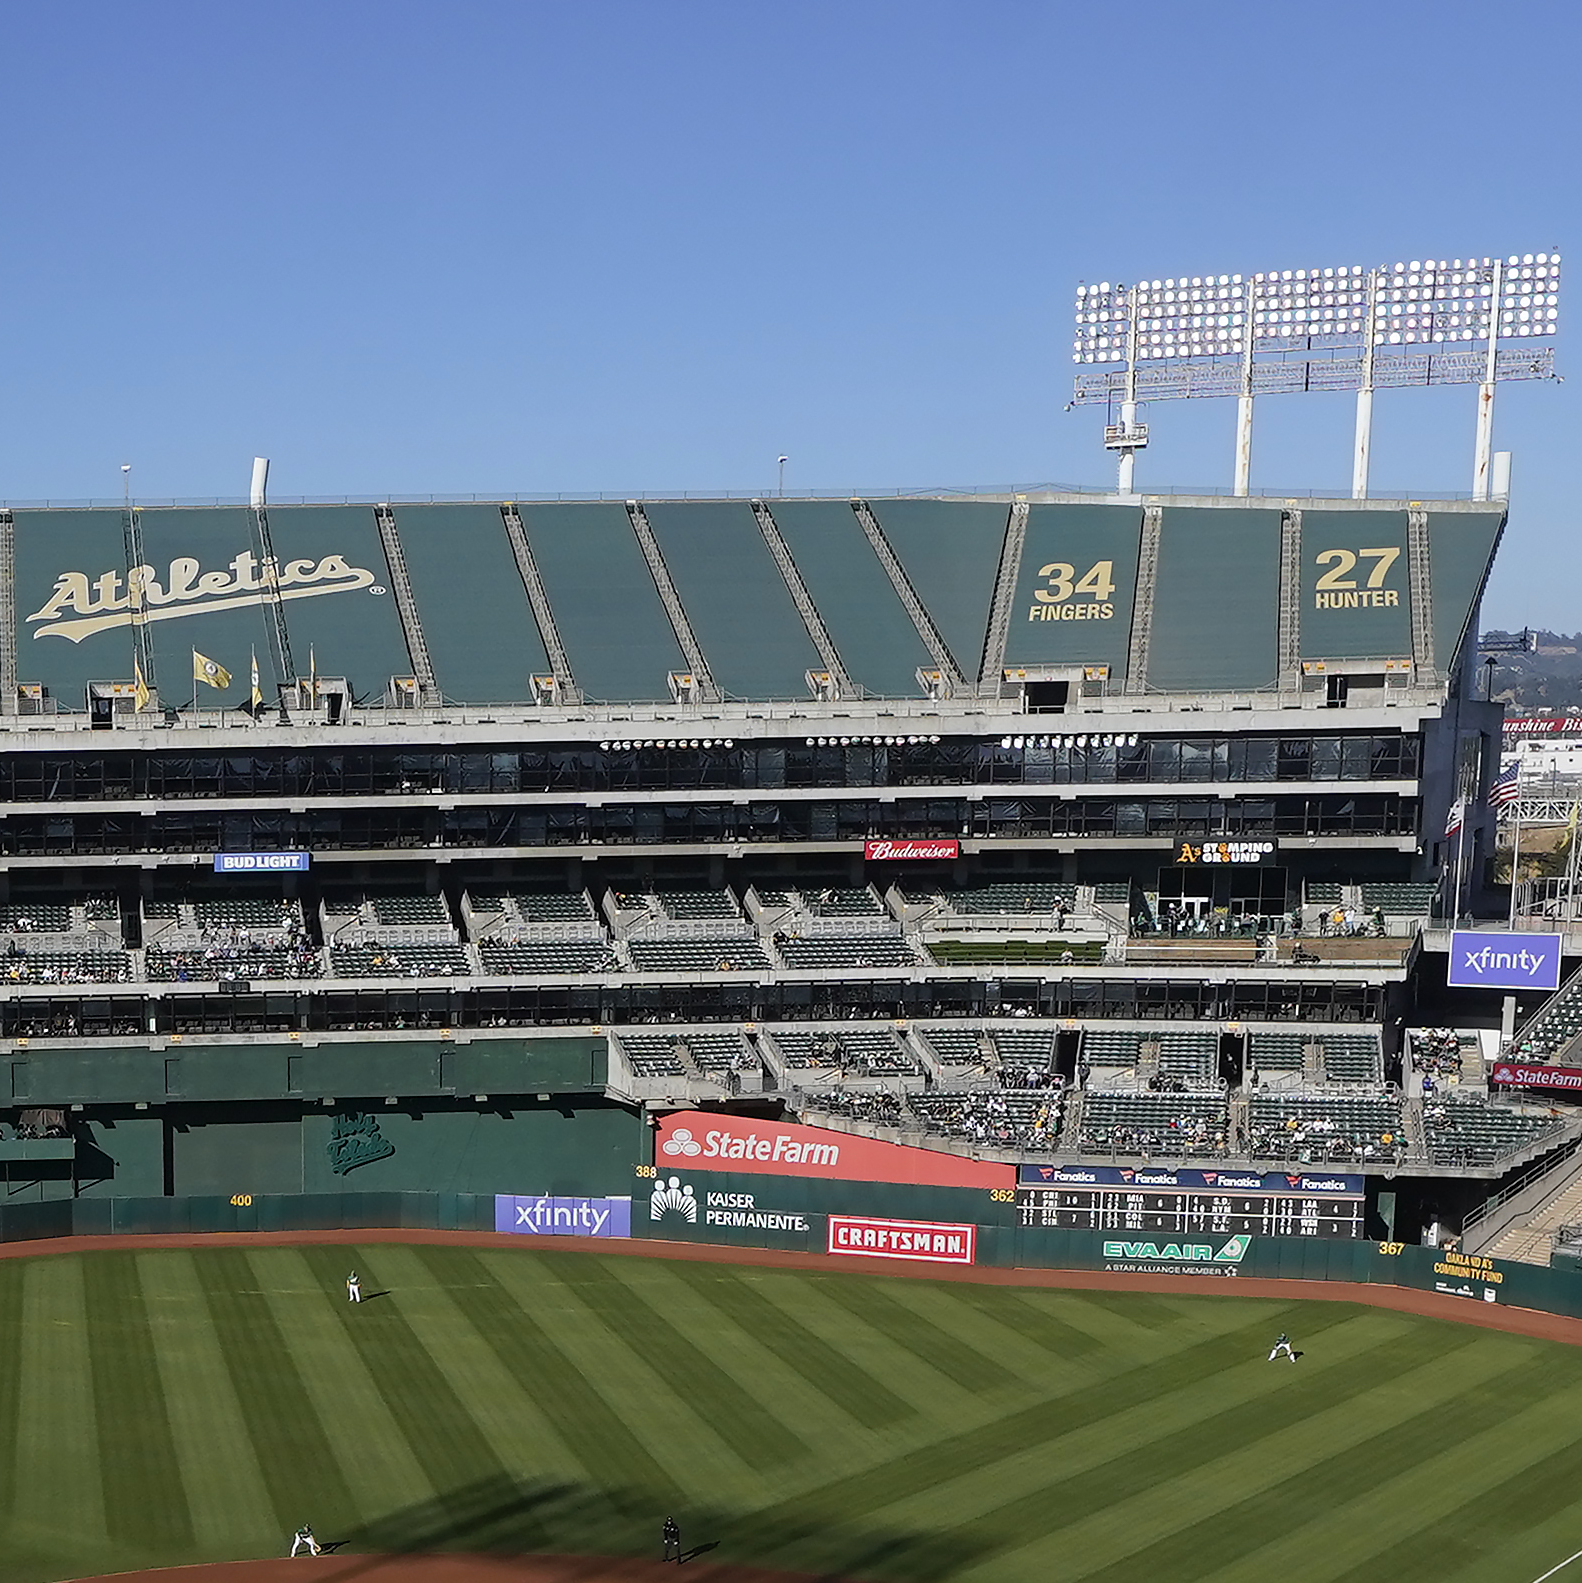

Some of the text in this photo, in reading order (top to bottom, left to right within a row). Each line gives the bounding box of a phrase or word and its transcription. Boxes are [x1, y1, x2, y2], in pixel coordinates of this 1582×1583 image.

[1315, 547, 1400, 589] 27
[1034, 560, 1115, 602] 34
[25, 550, 377, 643] Athletics
[1315, 590, 1399, 609] HUNTER
[1029, 602, 1115, 621] FINGERS
[1502, 718, 1555, 731] unshine
[869, 842, 954, 859] Budweiser
[1177, 843, 1201, 862] A's
[1202, 843, 1273, 853] STOMPING
[224, 856, 300, 868] BUD LIGHT
[1202, 853, 1260, 862] GROUND
[1465, 947, 1545, 976] xfinity
[635, 1165, 657, 1178] 388
[1054, 1171, 1096, 1182] Fanatics
[1135, 1173, 1177, 1184] Fanatics
[1218, 1176, 1261, 1187] Fanatics
[1302, 1179, 1346, 1190] Fanatics
[230, 1193, 252, 1207] 400
[707, 1192, 755, 1208] KAISER
[990, 1188, 1015, 1203] 362
[516, 1200, 609, 1235] xfinity
[706, 1212, 804, 1231] PERMANENTE
[1379, 1241, 1405, 1255] 367
[1446, 1252, 1493, 1269] OAKLAND A's
[1113, 1264, 1222, 1275] STAR ALLIANCE MEMBER
[1434, 1262, 1503, 1283] COMMUNITY FUND
